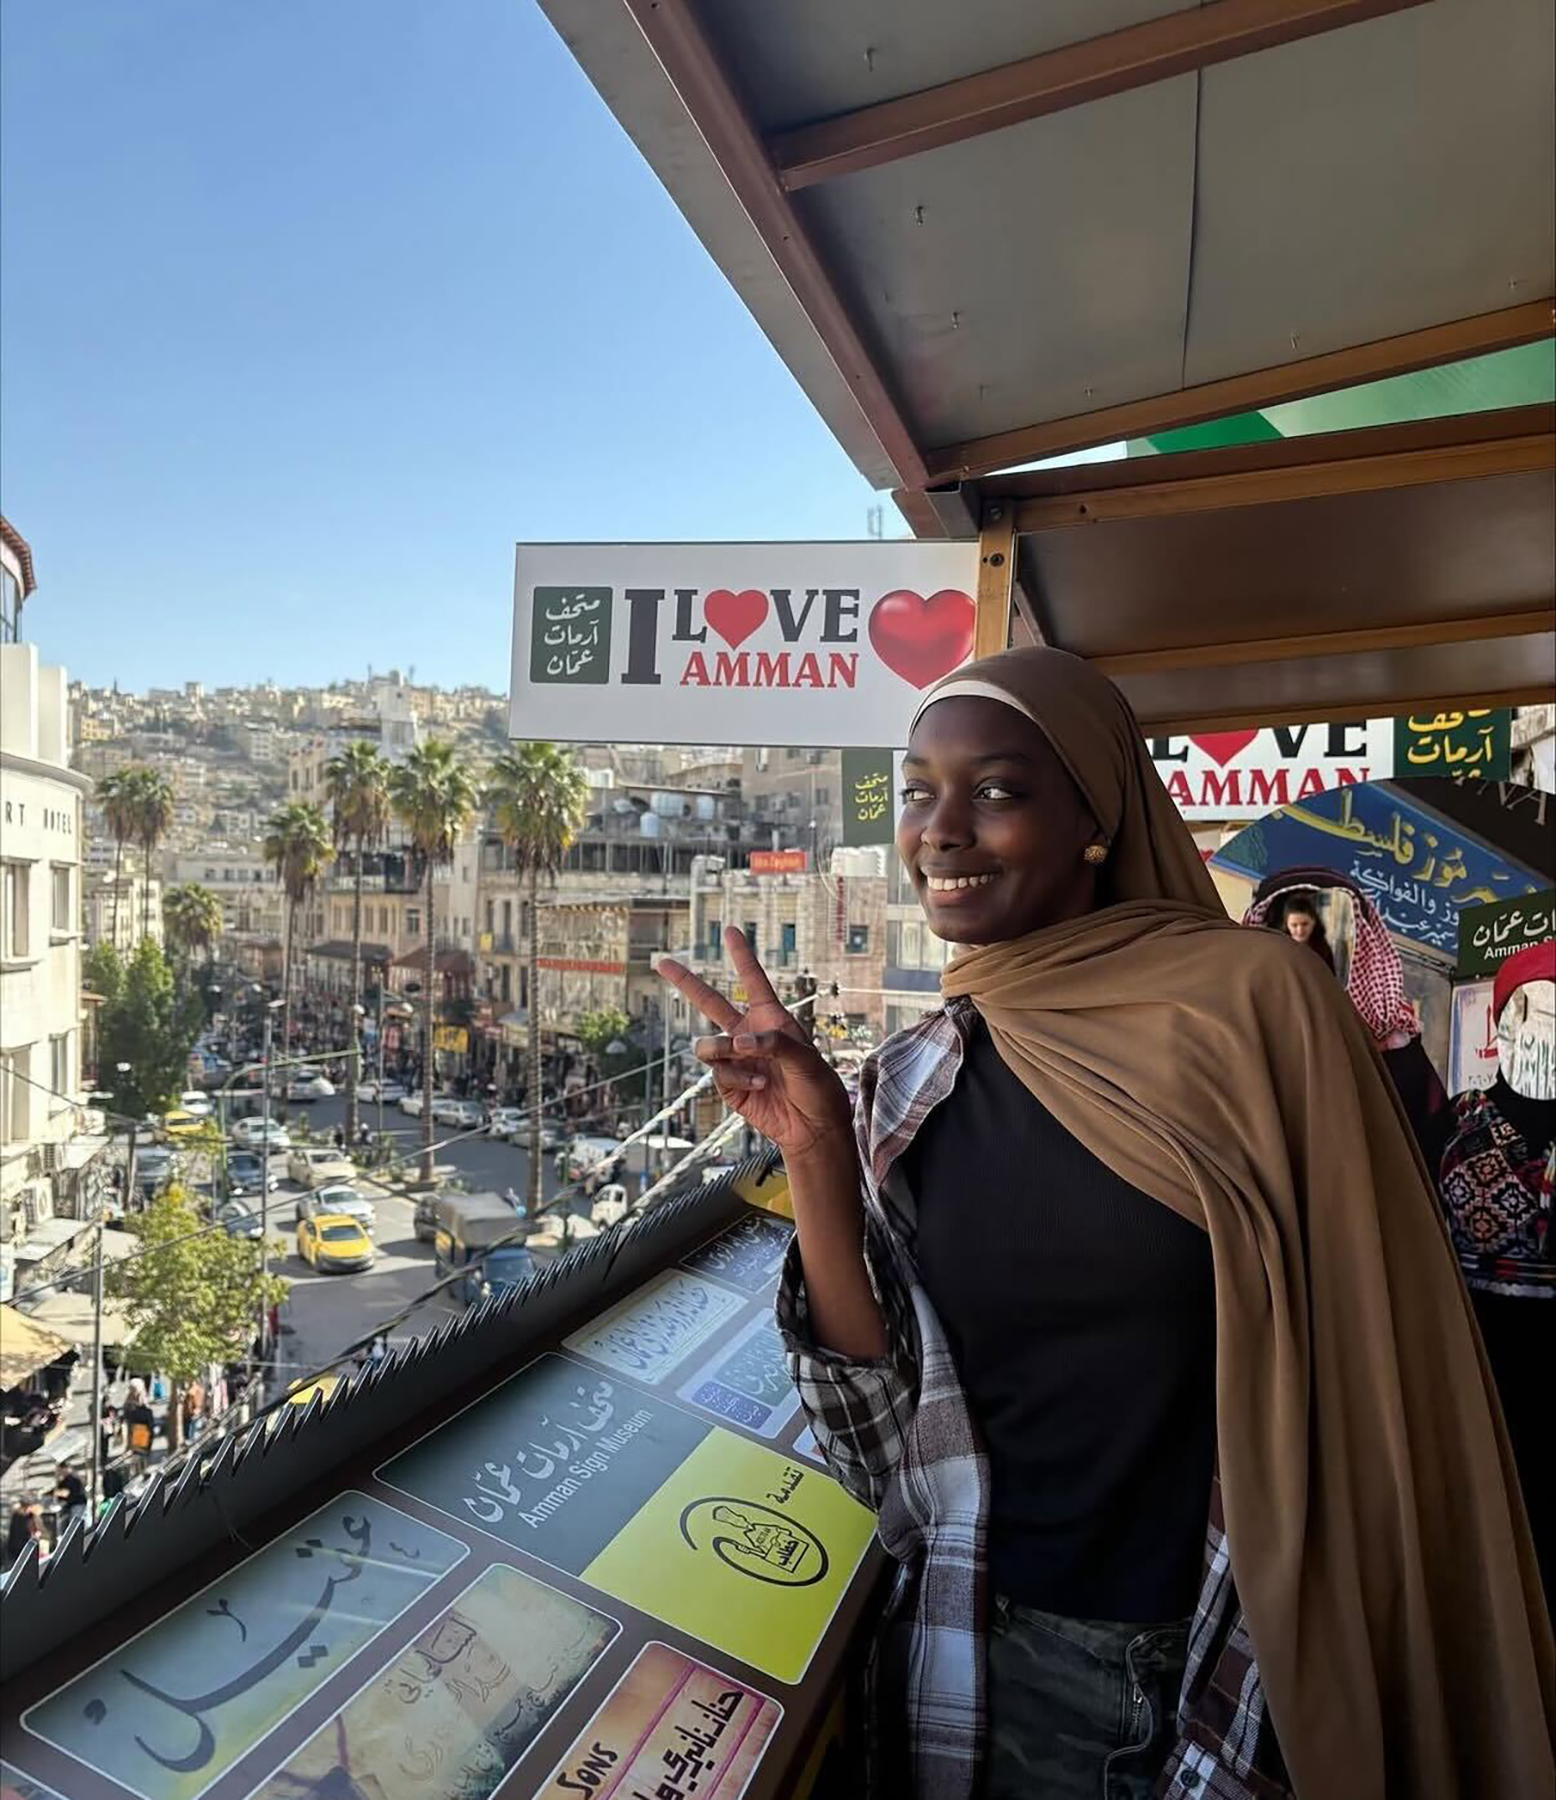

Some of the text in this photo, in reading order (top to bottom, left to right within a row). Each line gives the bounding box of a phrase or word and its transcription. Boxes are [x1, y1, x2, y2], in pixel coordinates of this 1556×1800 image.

[545, 595, 601, 620] متحف
[544, 620, 599, 646] آرمات
[621, 588, 666, 685] I
[679, 651, 860, 689] AMMAN
[1407, 726, 1494, 765] آرمات
[569, 1381, 614, 1432] متحف
[518, 1408, 655, 1529] Amman Sign Museum
[556, 1741, 619, 1800] SONS
